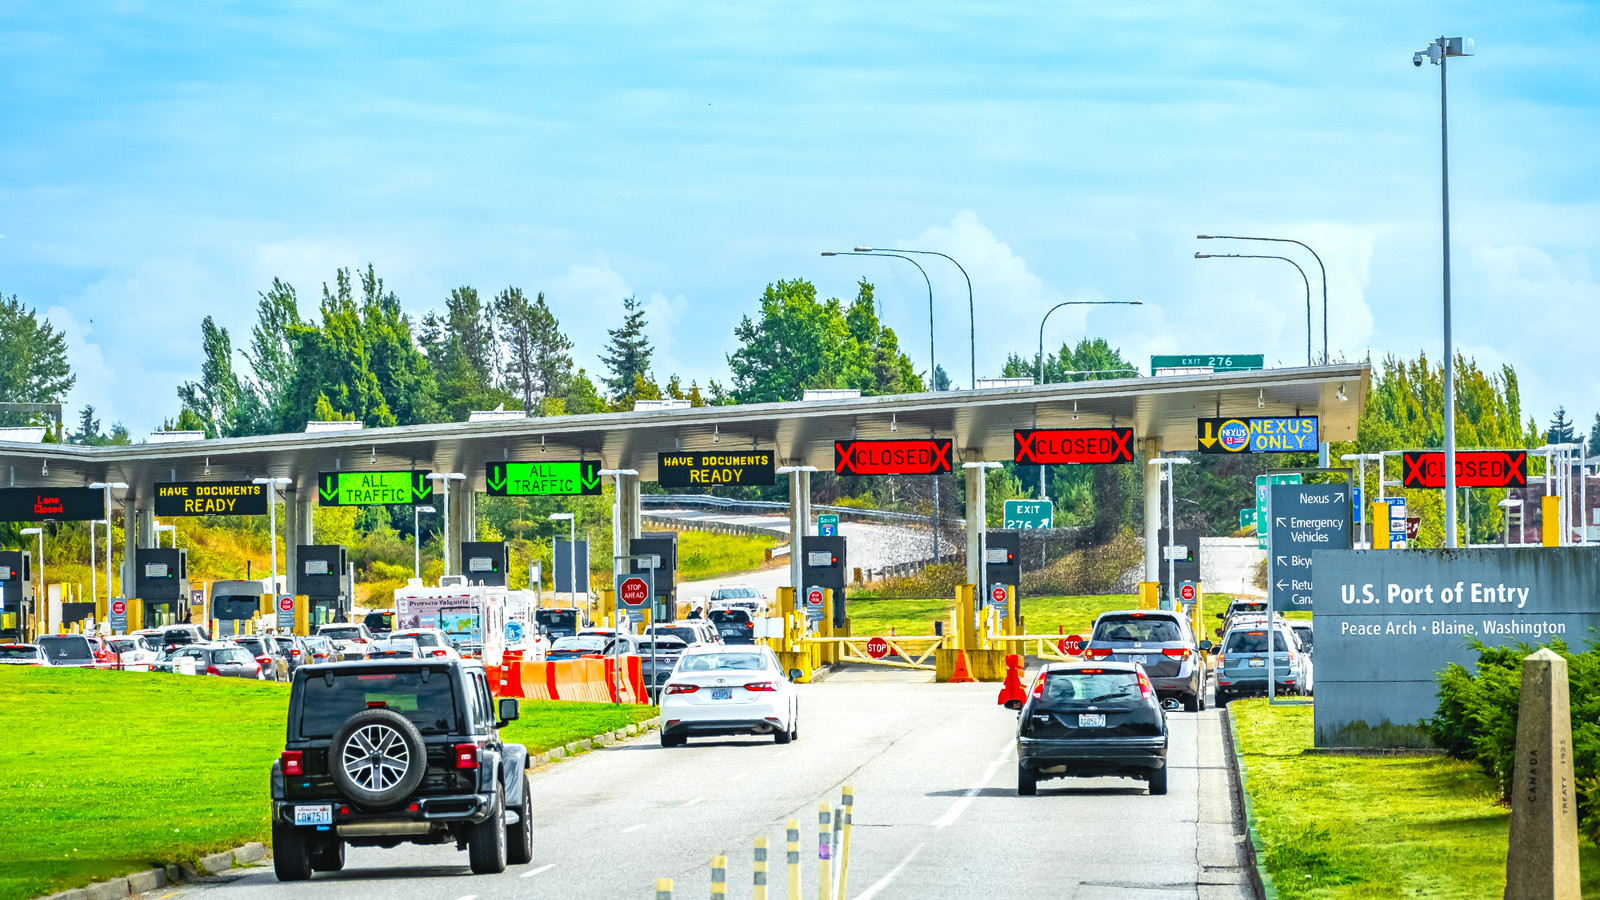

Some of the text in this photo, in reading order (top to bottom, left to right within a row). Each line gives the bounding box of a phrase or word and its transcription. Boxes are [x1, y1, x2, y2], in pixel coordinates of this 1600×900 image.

[1208, 356, 1232, 366] 276
[1222, 428, 1246, 437] NEXUS
[1250, 420, 1312, 433] NEXUS
[1036, 438, 1110, 454] CLOSED
[1256, 435, 1306, 449] ONLY
[664, 455, 768, 466] HAVE DOCUMENTS
[857, 449, 929, 465] CLOSED
[530, 465, 556, 477] ALL
[690, 469, 743, 483] READY
[362, 475, 388, 487] ALL
[514, 479, 573, 492] TRAFFIC
[160, 486, 260, 496] HAVE DOCUMENTS
[346, 489, 404, 502] TRAFFIC
[37, 495, 59, 505] Lane
[1300, 493, 1330, 504] Nexus
[34, 504, 63, 514] Closed
[185, 498, 236, 512] READY
[1017, 505, 1040, 514] EXIT
[1007, 520, 1032, 529] 276
[1291, 517, 1343, 530] Emergency
[825, 527, 831, 536] 5
[1291, 532, 1329, 542] Vehicles
[1341, 582, 1530, 608] U.S. Port of Entry
[1341, 620, 1566, 638] Peace Arch Blaine, Washington
[868, 644, 887, 652] STOP
[1065, 640, 1079, 650] STO
[1528, 750, 1538, 803] CANADA
